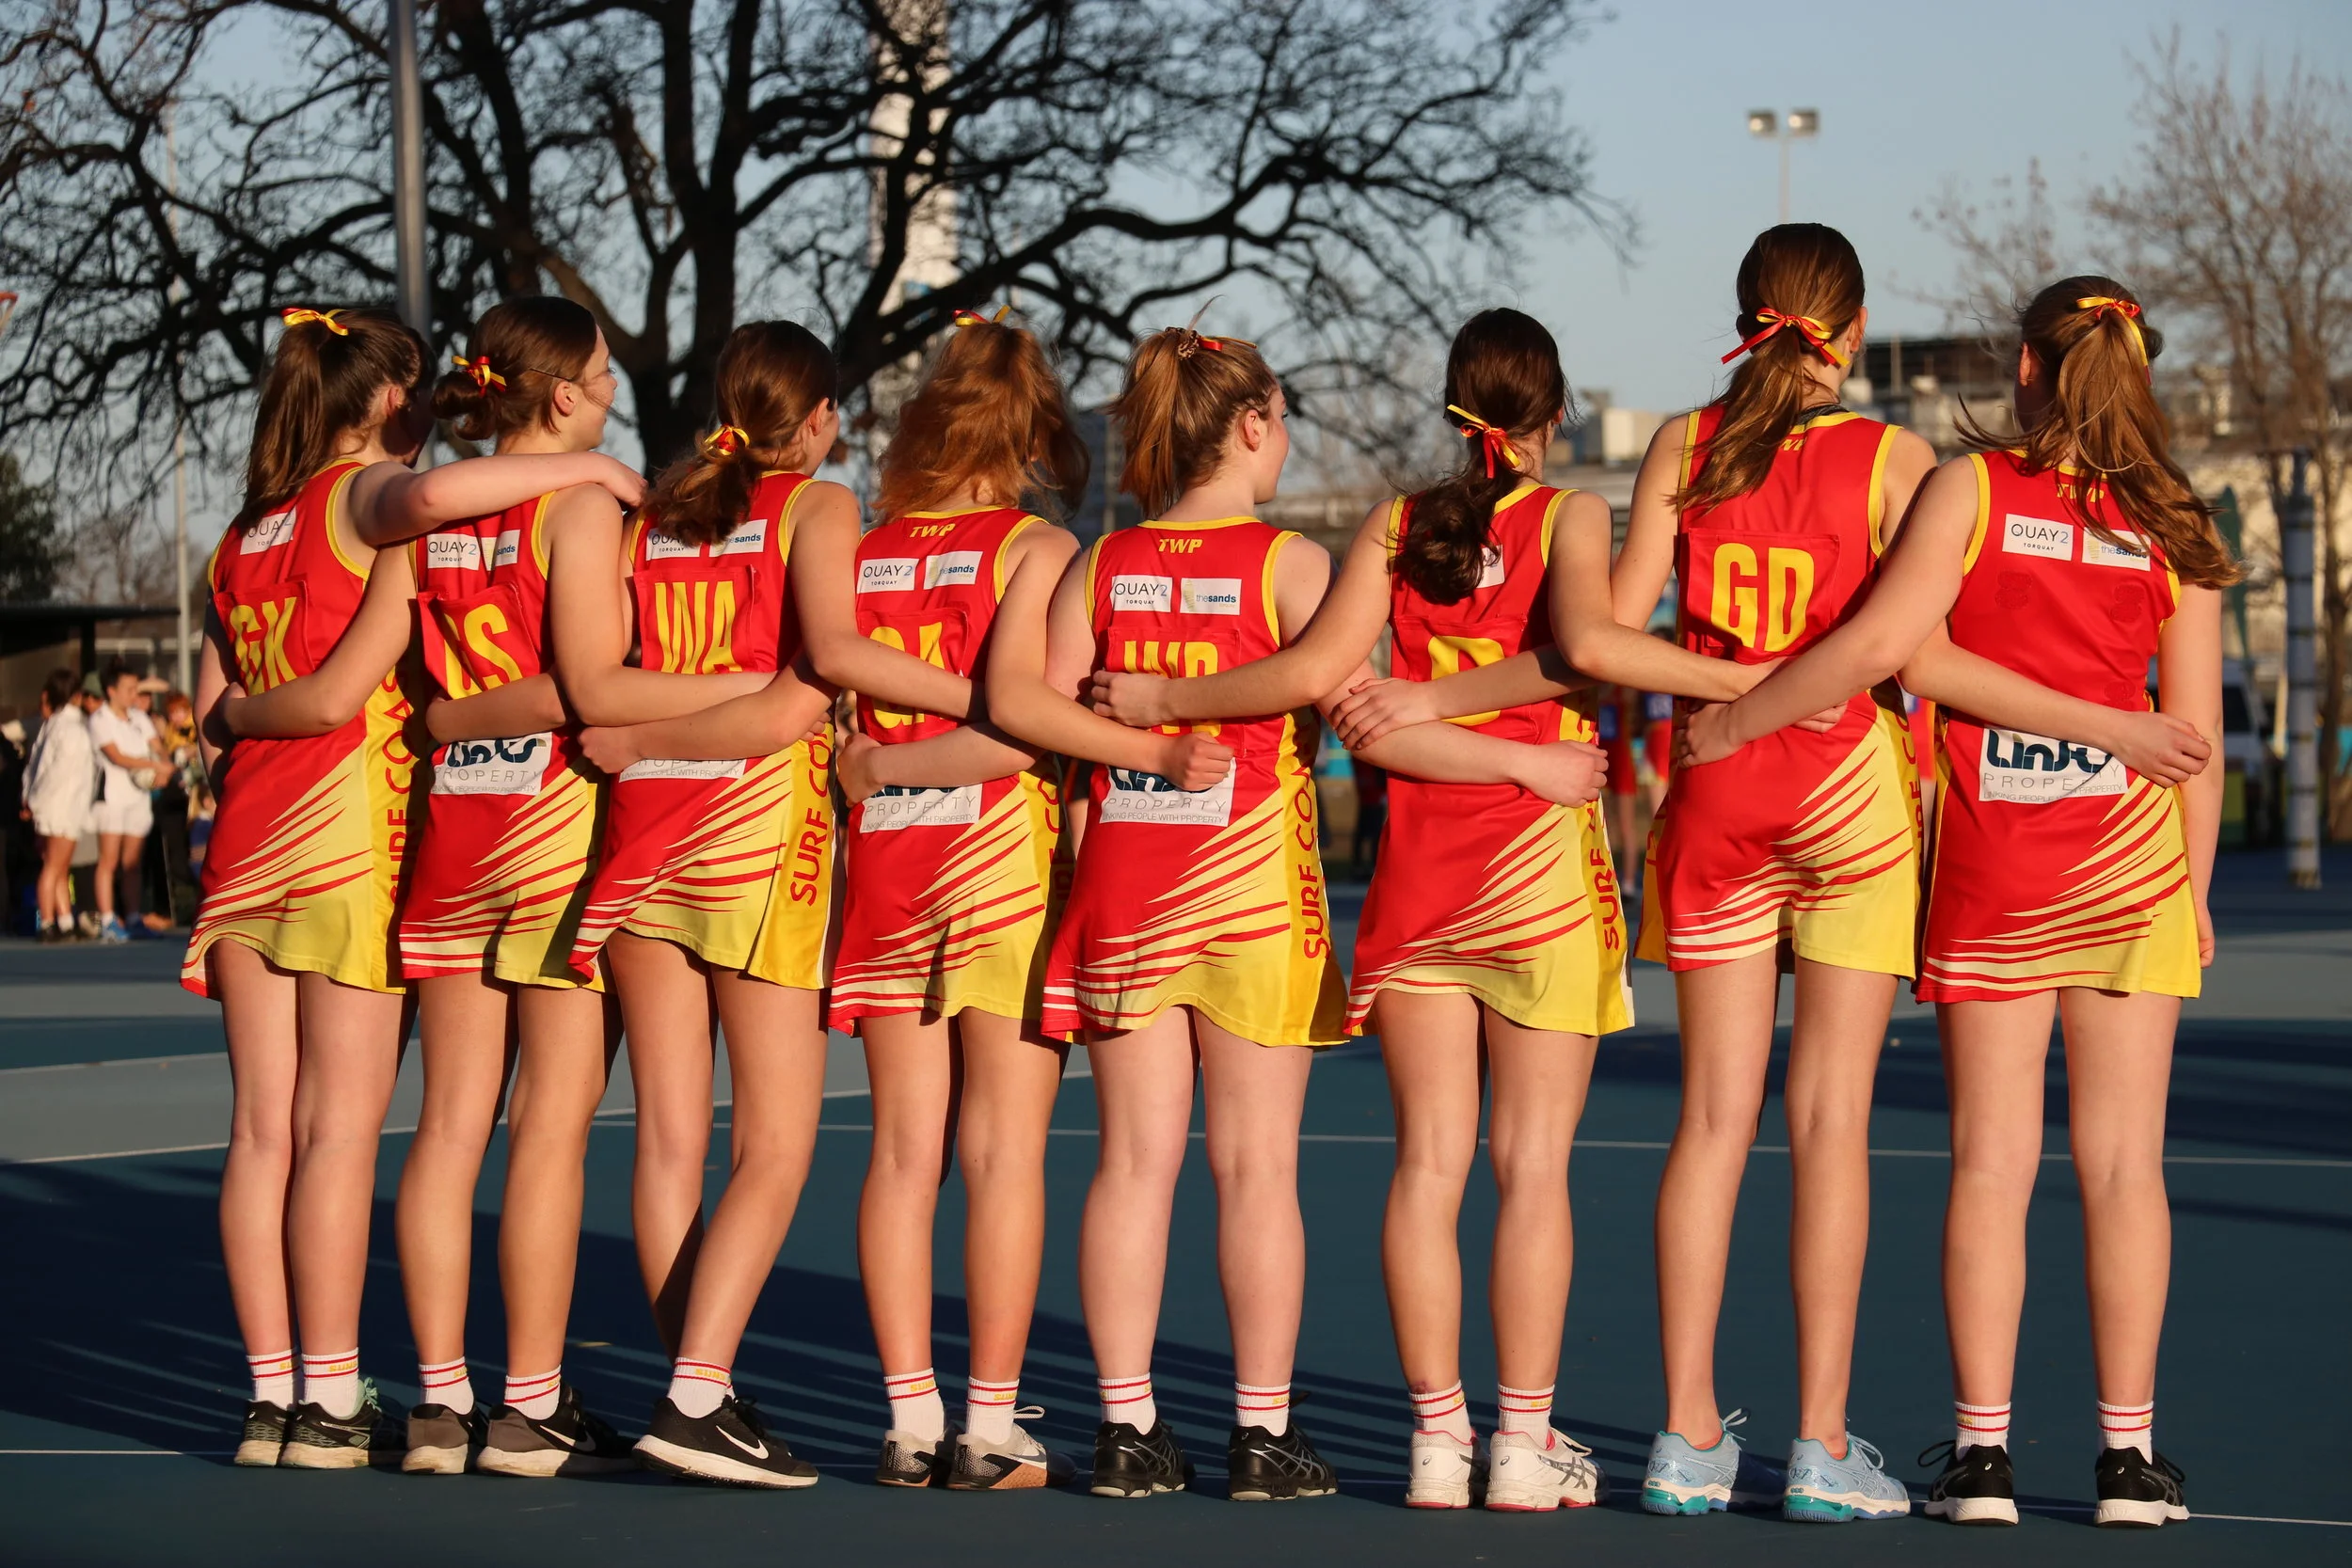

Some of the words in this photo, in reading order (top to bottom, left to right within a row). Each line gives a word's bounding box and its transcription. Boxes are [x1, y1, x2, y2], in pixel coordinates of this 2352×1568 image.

[910, 523, 956, 538] TWP
[1158, 538, 1203, 553] TWP
[2023, 543, 2054, 551] TORQUAY
[655, 580, 742, 674] WA
[1710, 542, 1815, 652] GD
[230, 597, 297, 695] GK
[1104, 797, 1226, 812] PROPERTY
[1128, 812, 1155, 821] PEOPLE
[1181, 815, 1223, 824] PROPERTY
[789, 807, 828, 907] SURF
[1590, 848, 1620, 951] SURF
[1296, 864, 1330, 959] SURF
